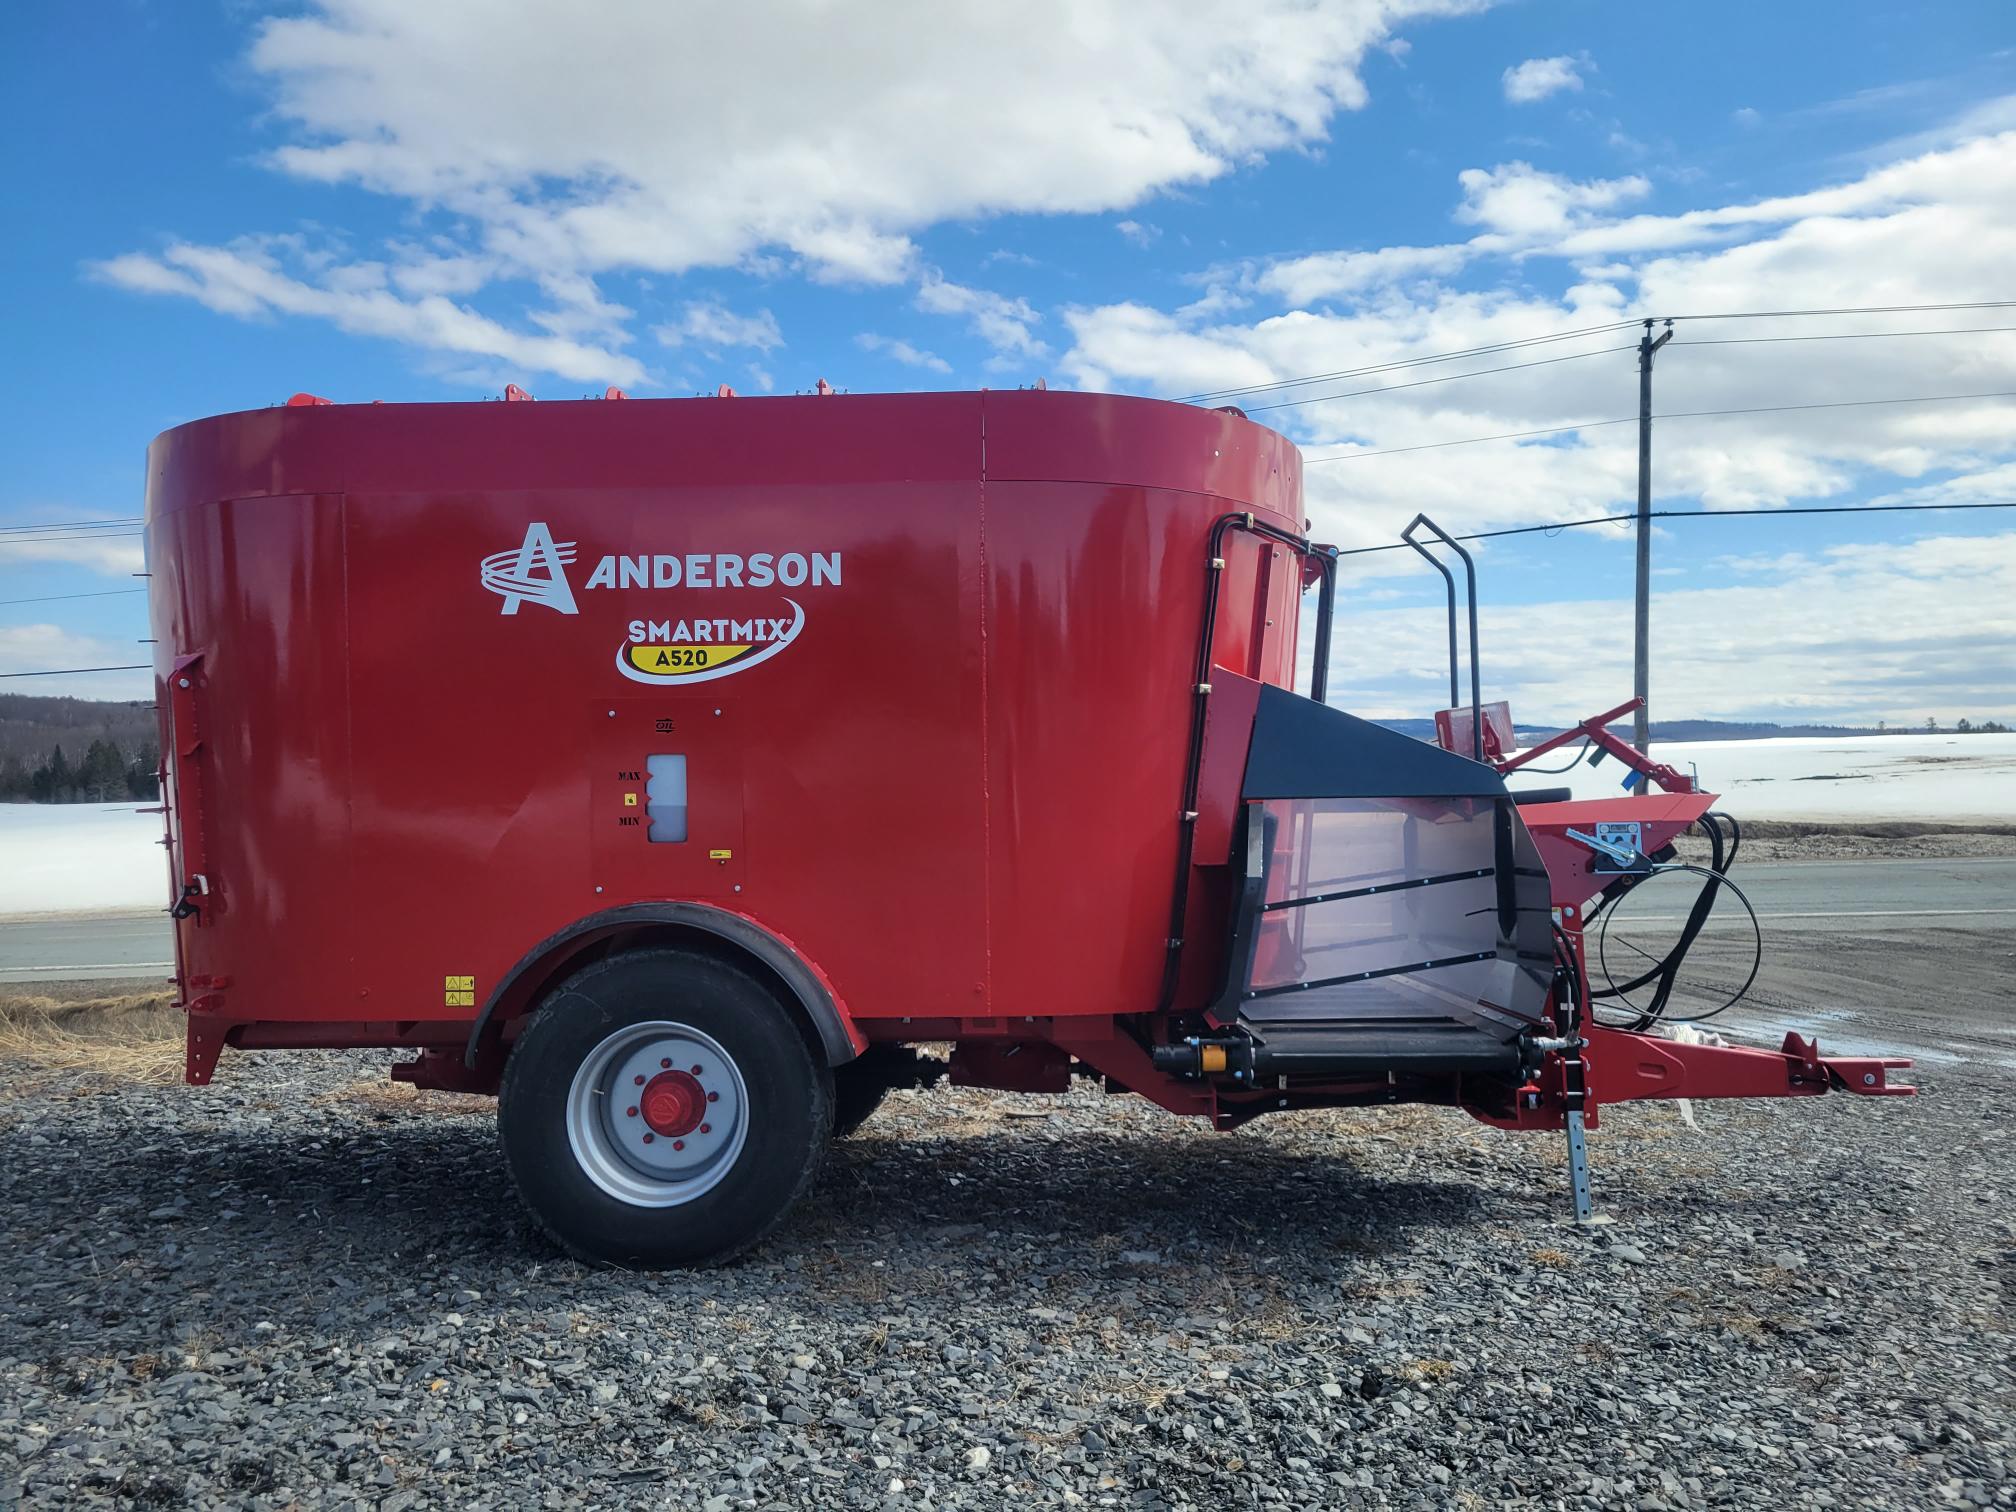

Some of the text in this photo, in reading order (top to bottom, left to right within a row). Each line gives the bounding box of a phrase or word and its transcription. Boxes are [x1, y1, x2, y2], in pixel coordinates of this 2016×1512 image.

[585, 551, 842, 589] ANDERSON
[655, 649, 708, 667] A520
[618, 771, 641, 781] MAX
[618, 817, 640, 826] MIN
